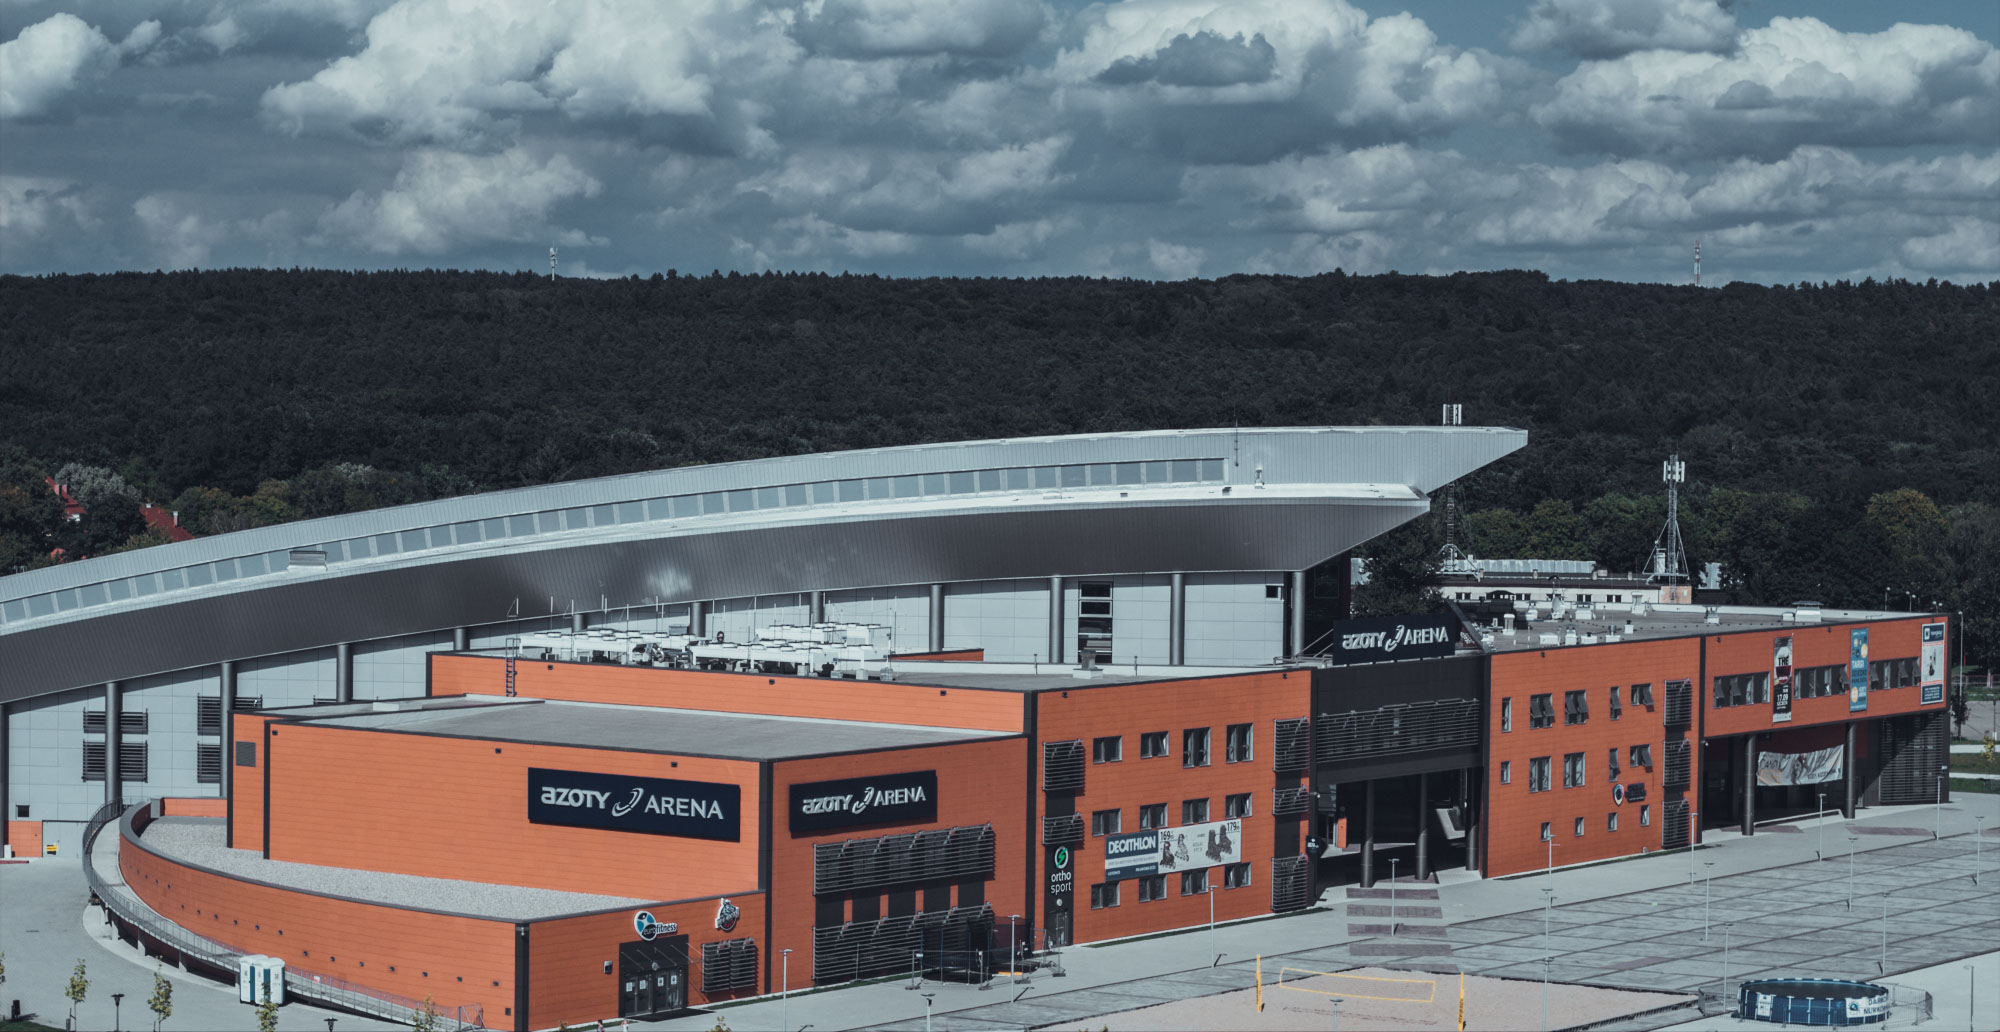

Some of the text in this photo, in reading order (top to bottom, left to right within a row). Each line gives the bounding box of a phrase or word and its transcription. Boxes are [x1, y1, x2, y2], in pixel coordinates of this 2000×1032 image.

[1403, 626, 1449, 646] ARENA
[873, 786, 927, 807] ARENA
[644, 795, 724, 820] ARENA
[1108, 835, 1156, 855] DECATHLON
[1051, 870, 1072, 882] ortho
[1050, 882, 1072, 895] sport
